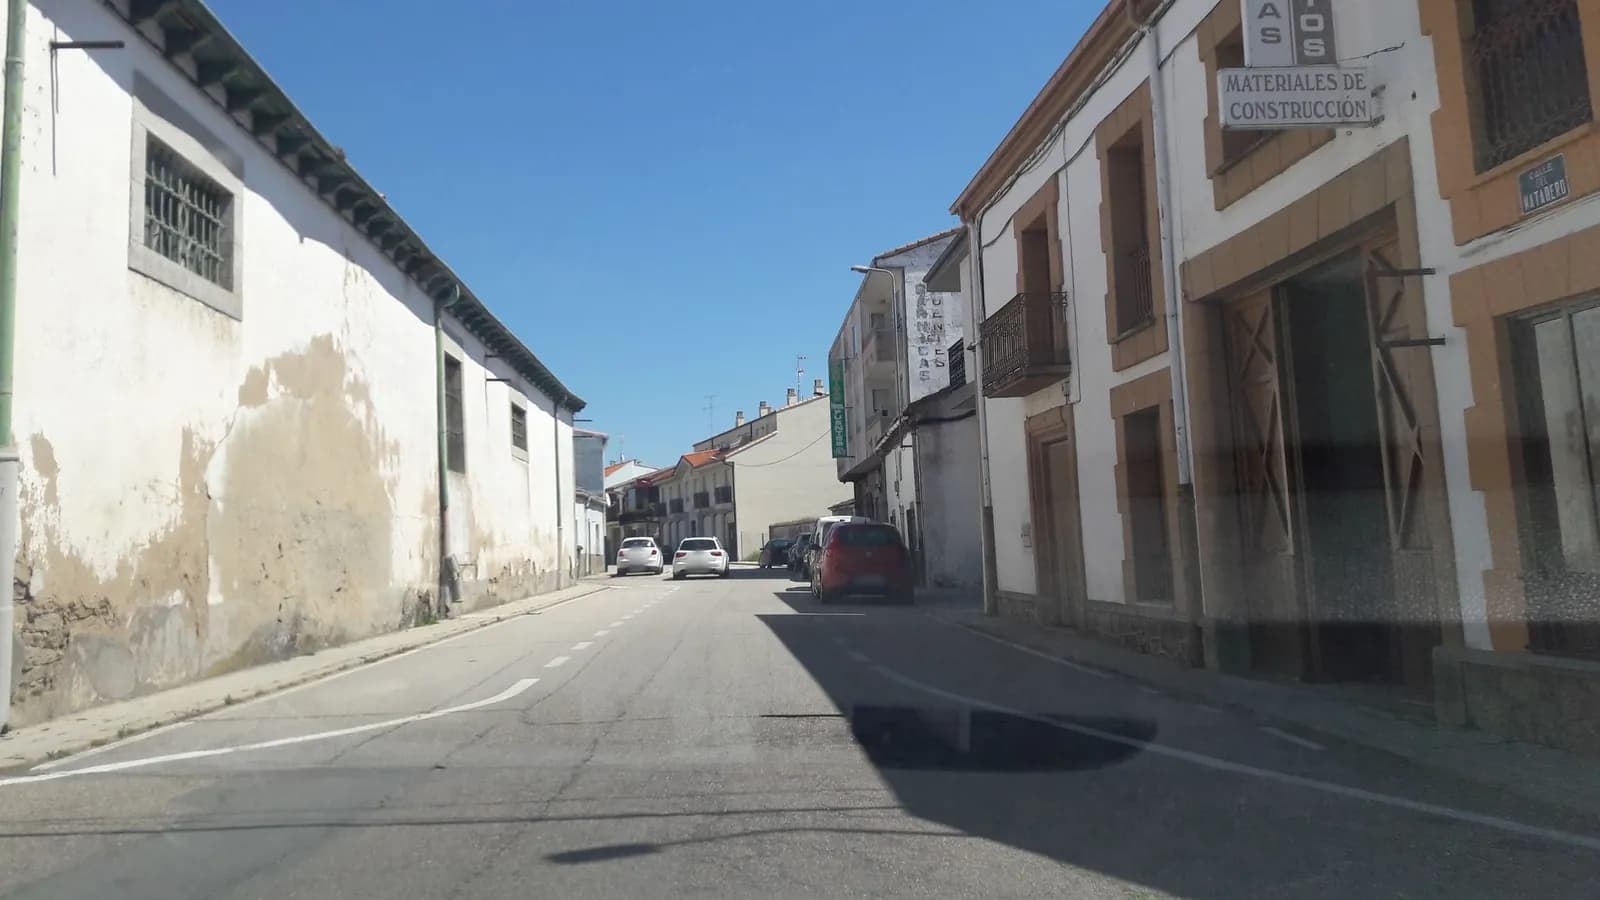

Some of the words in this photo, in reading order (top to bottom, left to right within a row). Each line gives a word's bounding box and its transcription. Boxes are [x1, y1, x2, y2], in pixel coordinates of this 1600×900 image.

[1225, 73, 1338, 92] MATERIALES
[1343, 73, 1367, 91] DE
[1230, 95, 1367, 120] CONSTRUCCIÓN
[1523, 179, 1567, 211] MATADERO
